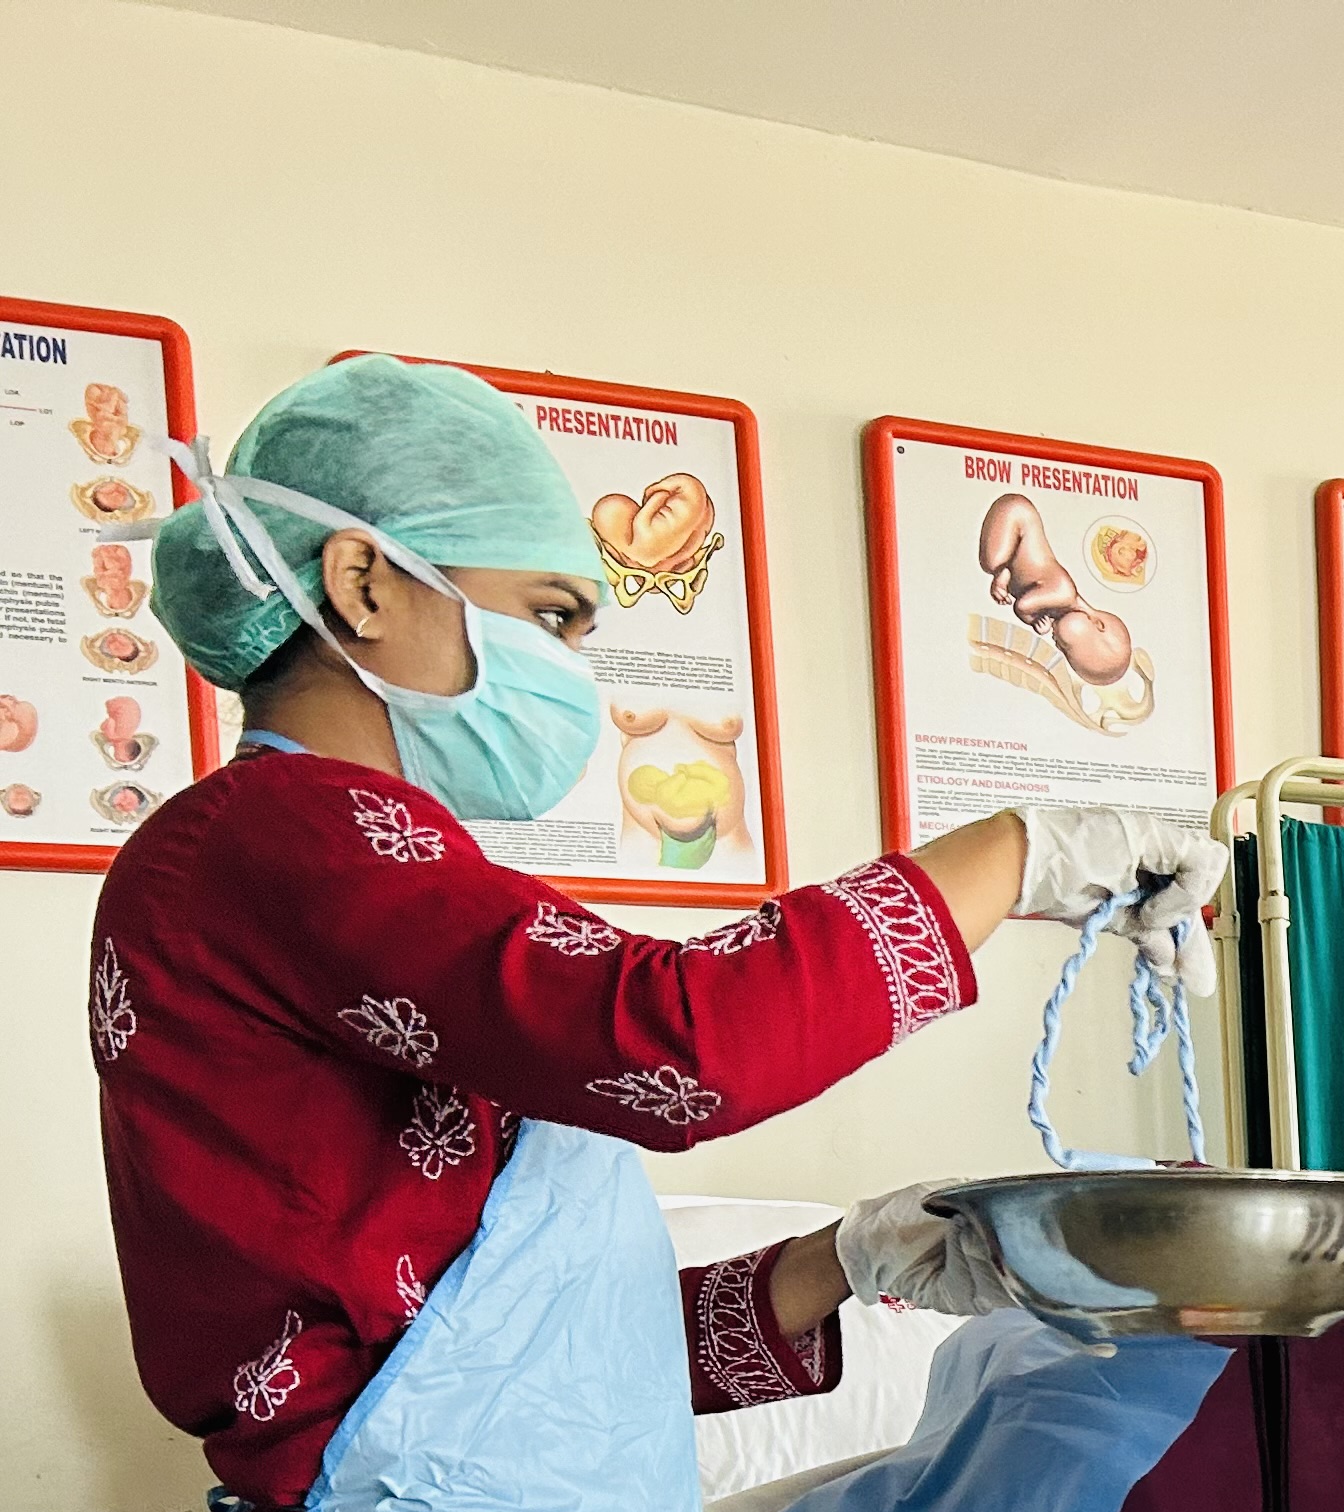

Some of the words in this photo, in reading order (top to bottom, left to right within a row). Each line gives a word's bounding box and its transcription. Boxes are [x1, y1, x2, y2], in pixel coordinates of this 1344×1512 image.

[0, 332, 67, 365] ATION
[536, 404, 678, 446] PRESENTATION
[964, 455, 1011, 484] BROW
[1021, 463, 1139, 501] PRESENTATION
[915, 734, 947, 745] BROW
[949, 736, 1028, 752] PRESENTATION
[917, 775, 970, 786] ETIOLOGY
[972, 779, 992, 788] AND
[994, 781, 1050, 793] DIAGNOSIS
[919, 821, 960, 831] MECHA
